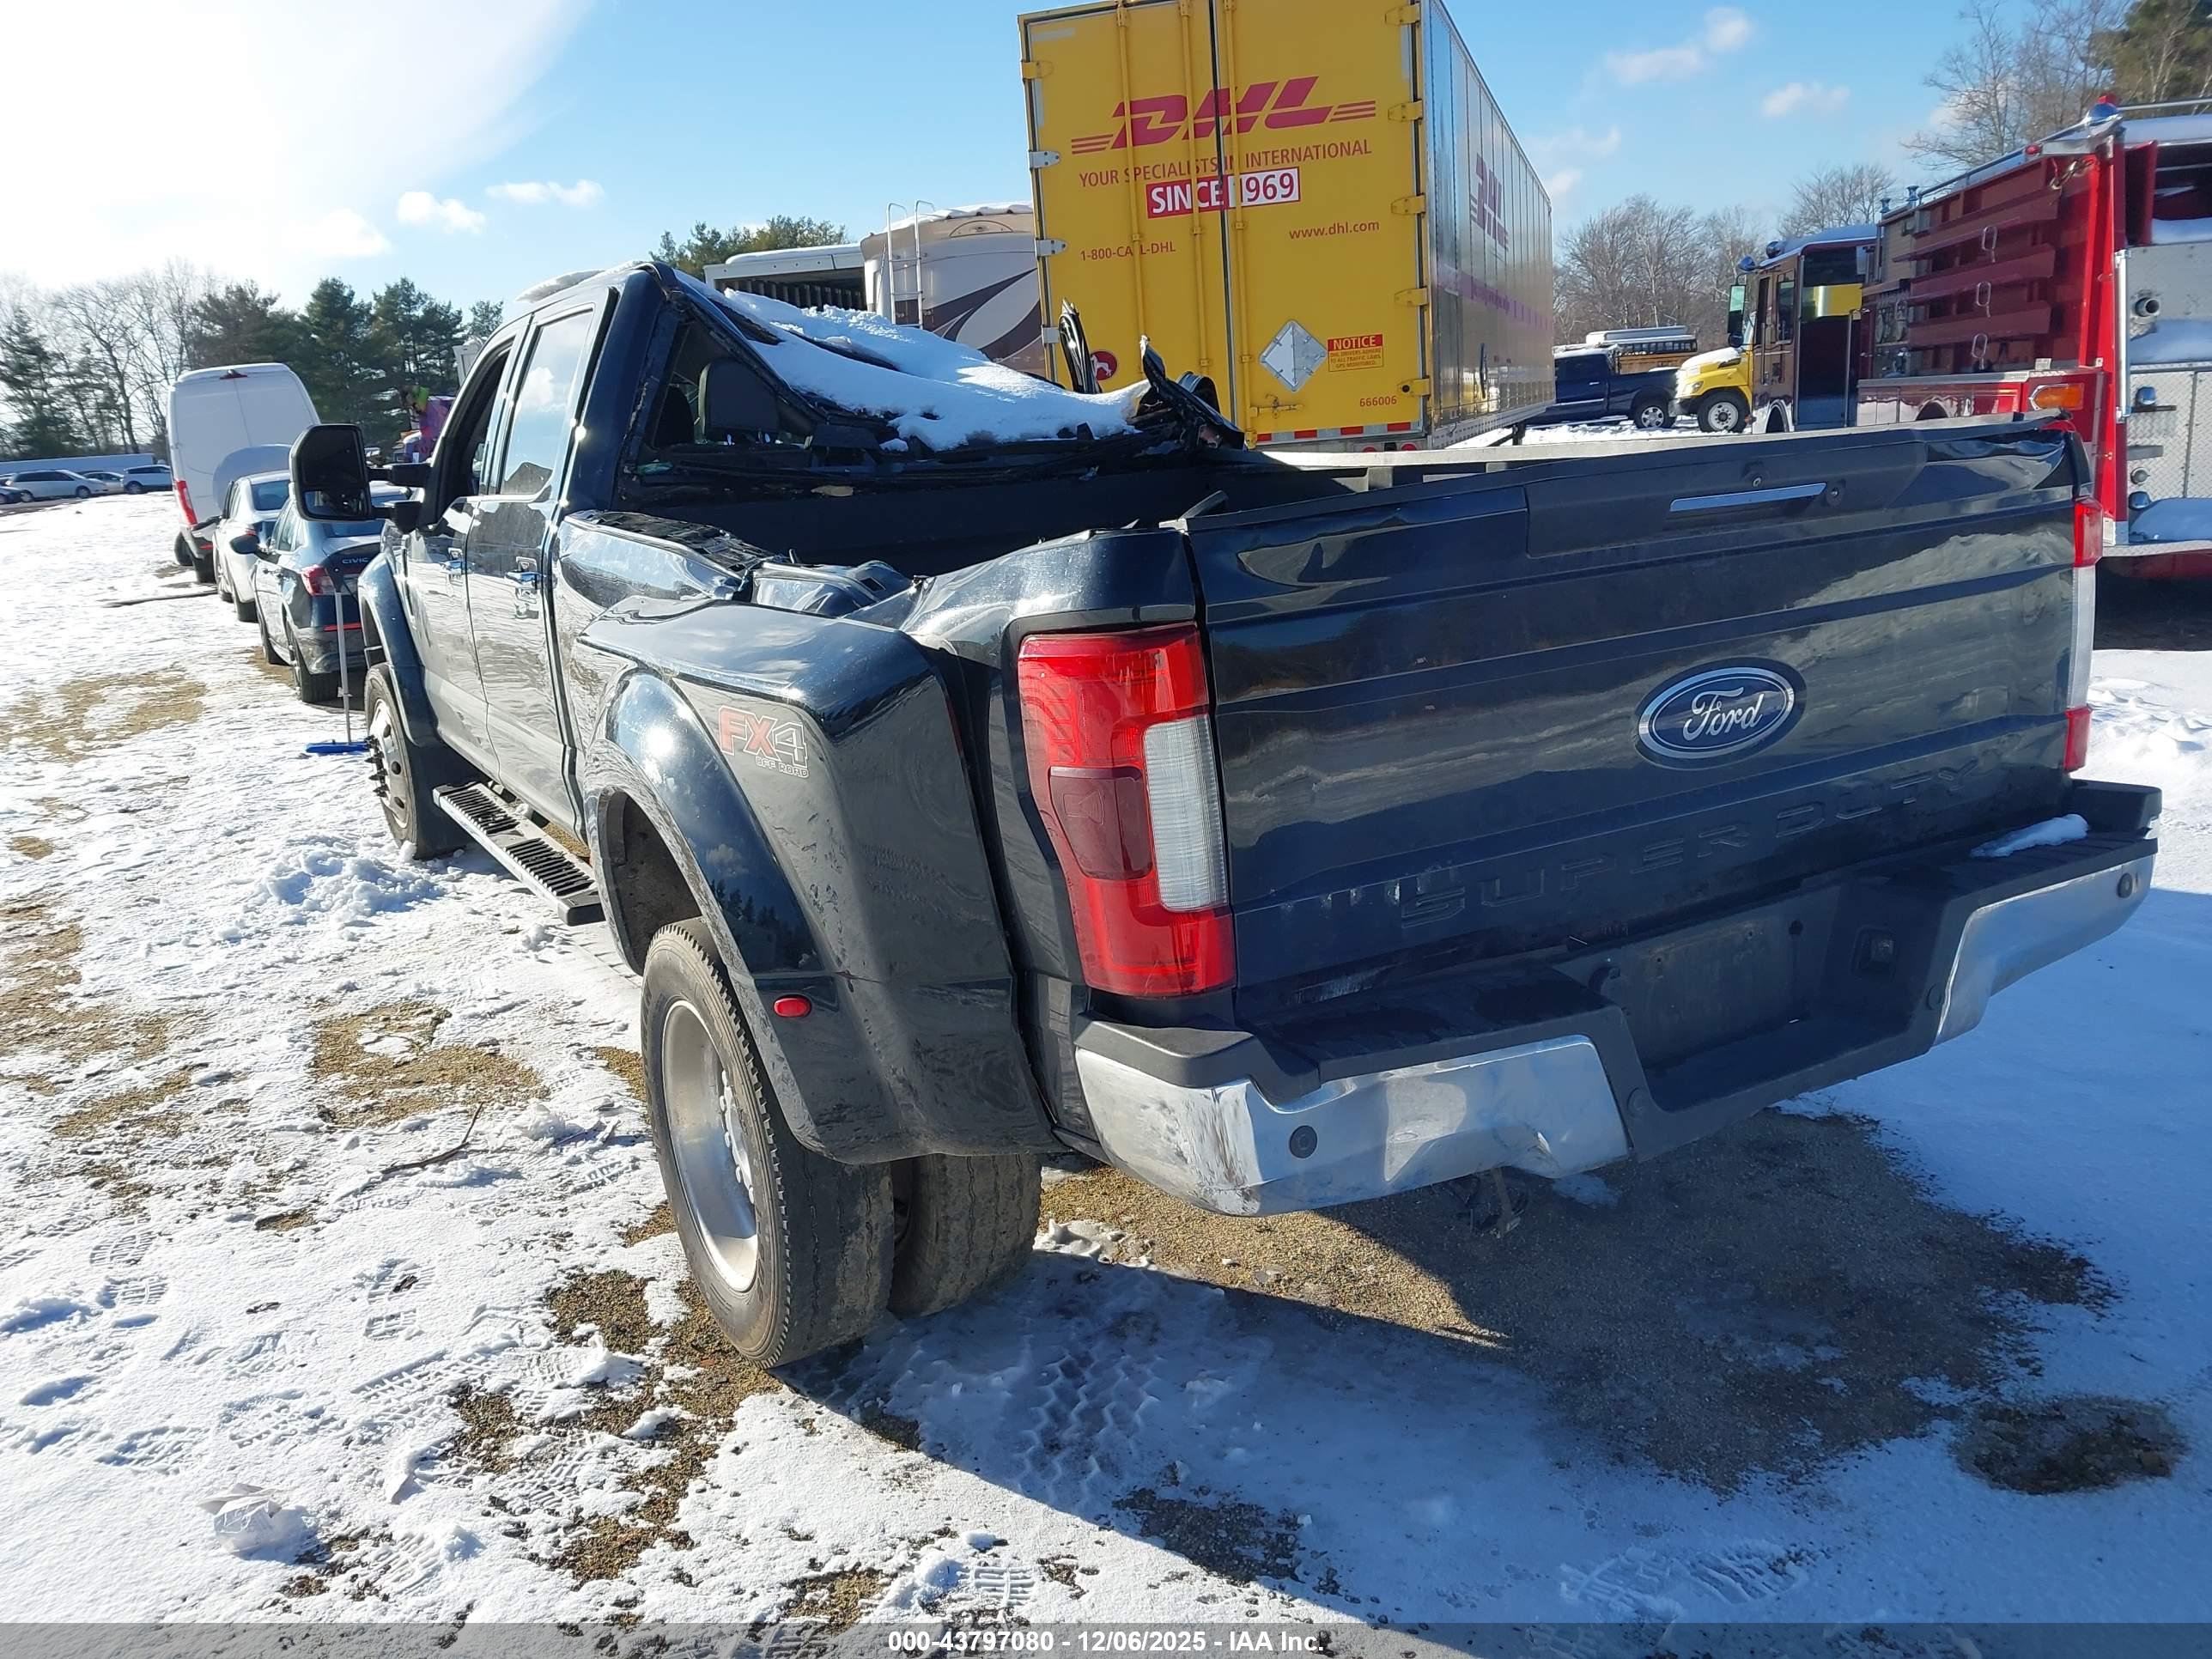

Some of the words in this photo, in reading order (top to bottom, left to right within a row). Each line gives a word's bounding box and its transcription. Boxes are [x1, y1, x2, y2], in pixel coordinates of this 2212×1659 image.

[1111, 76, 1334, 149] DHL
[1079, 169, 1120, 187] YOUR
[1246, 139, 1372, 169] INTERNATIONAL
[1150, 179, 1224, 214] SINCE
[1289, 220, 1380, 240] www.dhl.com
[1080, 241, 1176, 261] 1-800-CAL-DHL
[1333, 335, 1376, 349] NOTICE
[1359, 395, 1397, 407] 666006
[1682, 686, 1765, 741] Ford
[719, 705, 807, 769] FX4
[756, 756, 776, 769] OFF
[777, 761, 810, 779] ROAD
